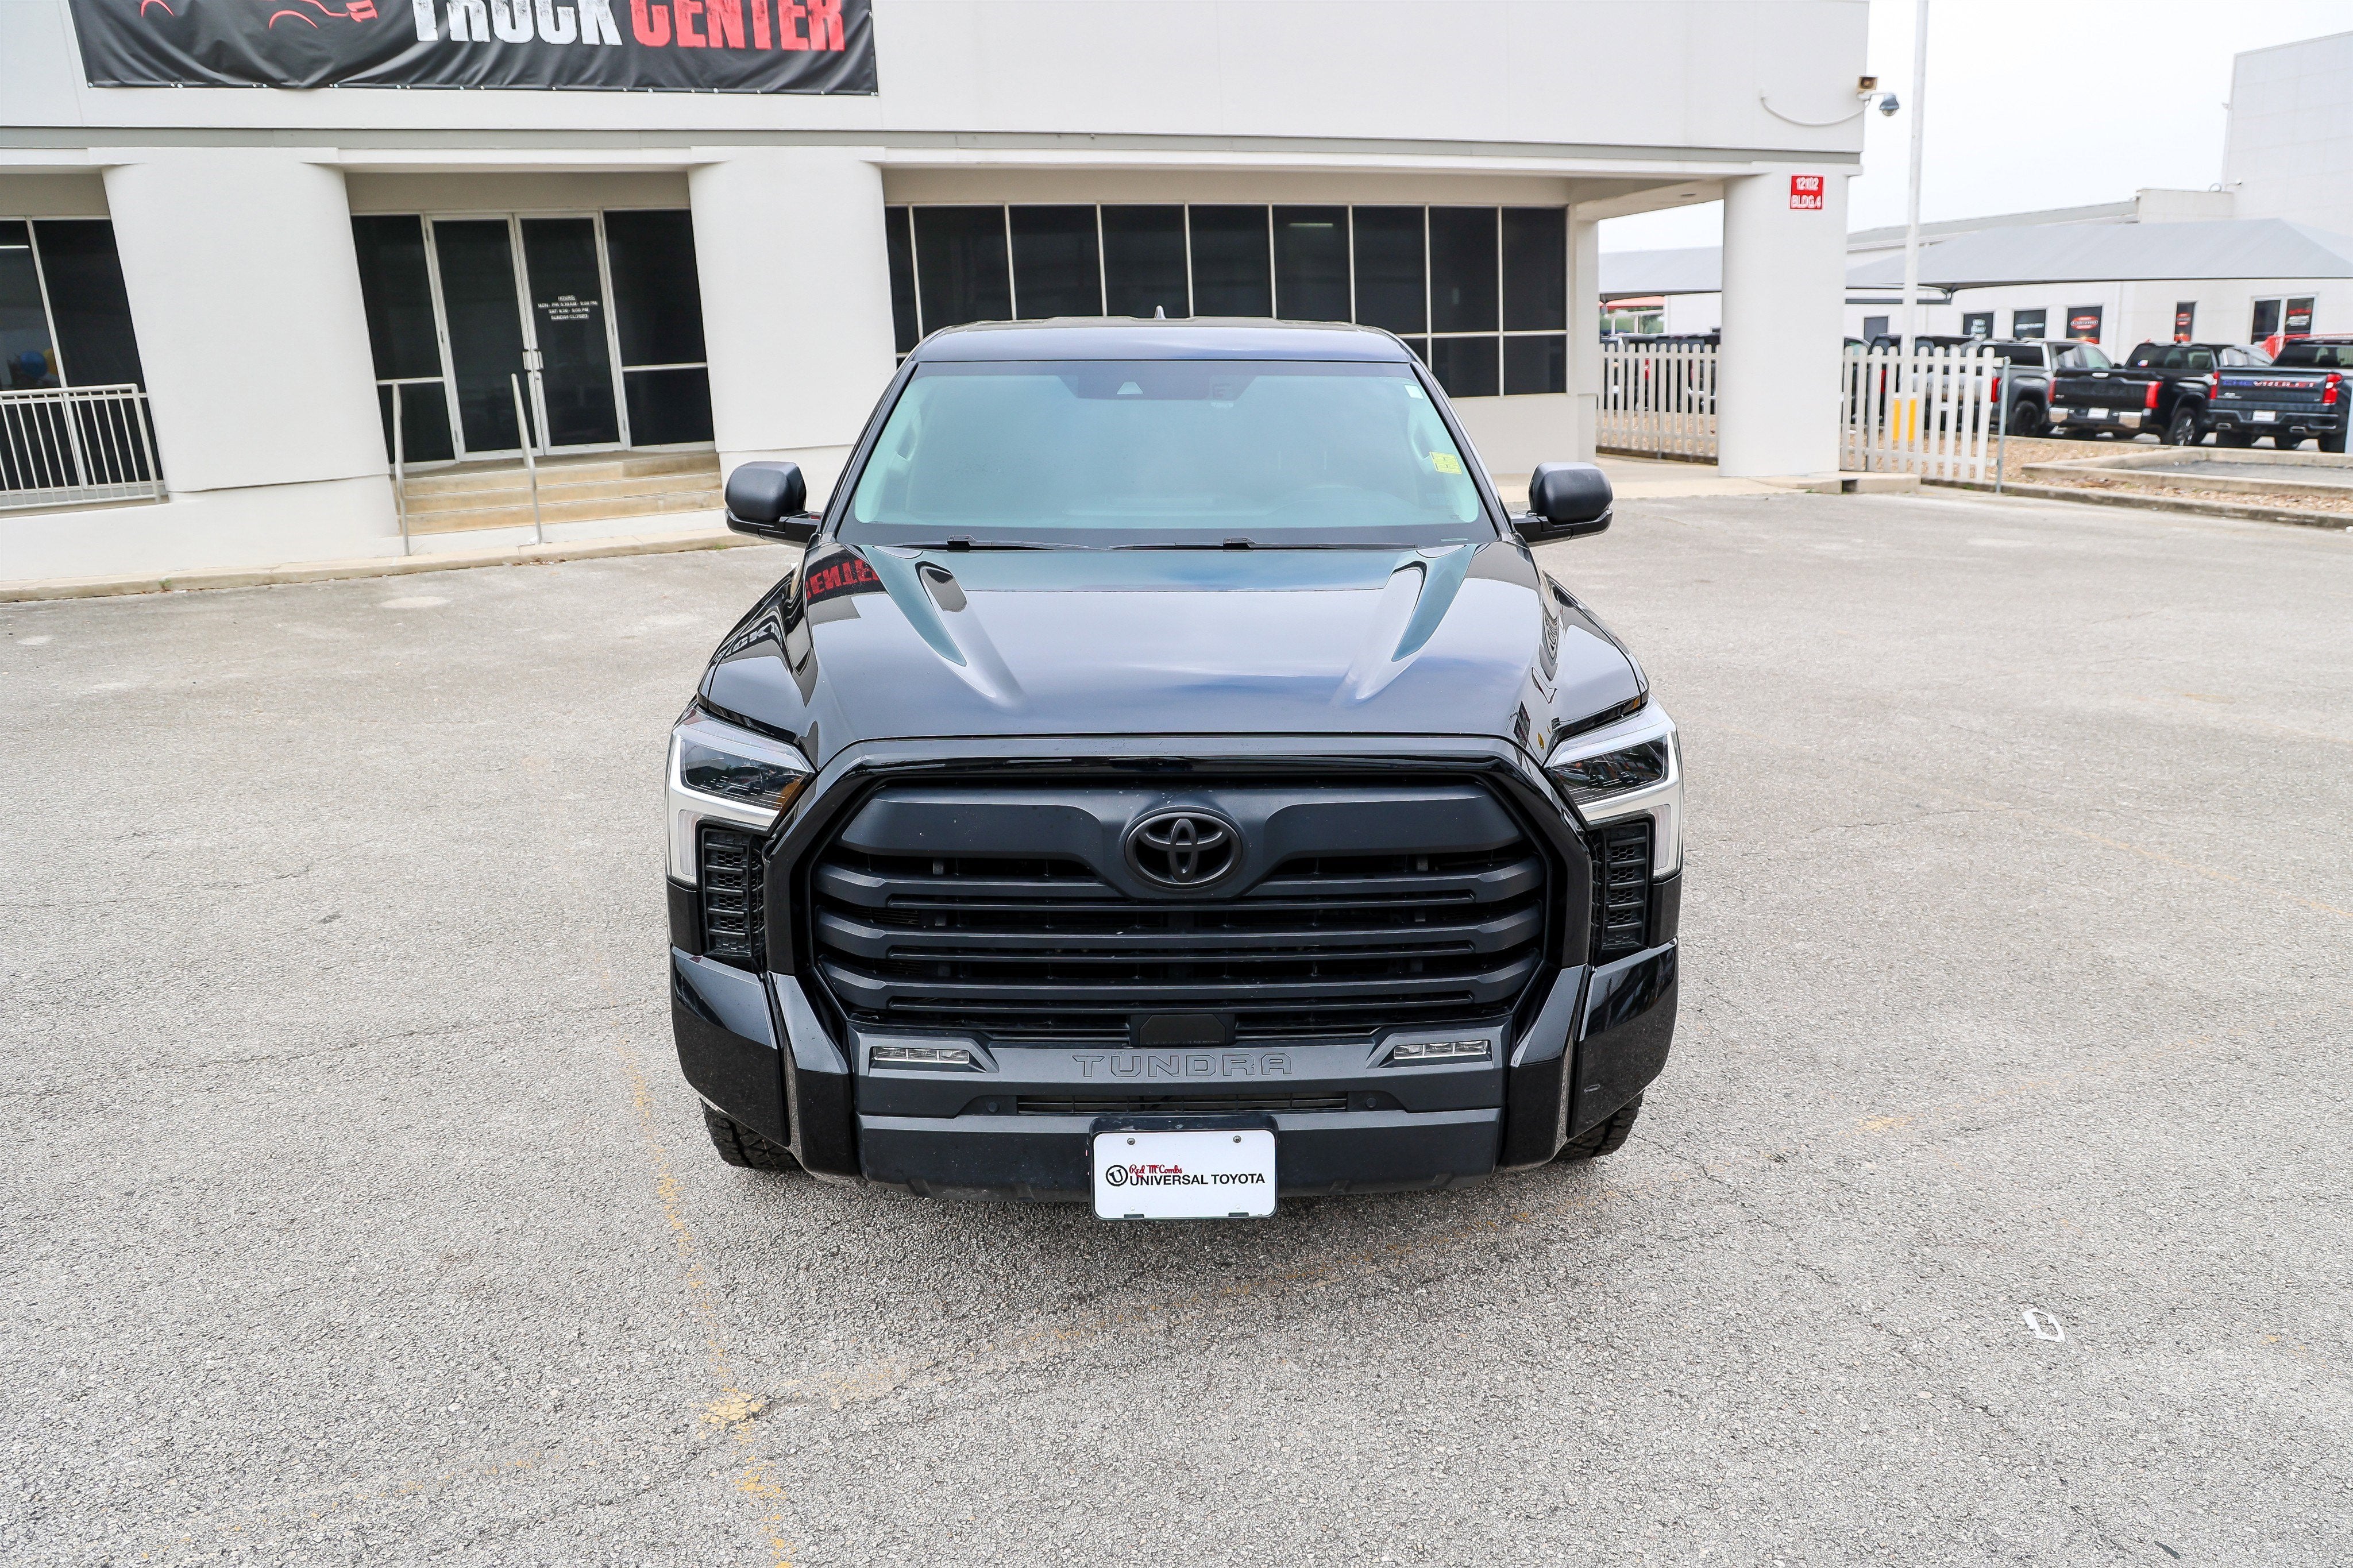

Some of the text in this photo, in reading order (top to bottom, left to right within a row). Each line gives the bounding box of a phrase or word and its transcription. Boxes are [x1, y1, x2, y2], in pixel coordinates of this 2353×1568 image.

[630, 0, 845, 51] CENTER
[1796, 177, 1819, 191] 12102
[1071, 1053, 1293, 1077] TUNDRA
[1129, 1164, 1182, 1178] Red McCombs
[1129, 1173, 1209, 1186] UNIVERSAL
[1211, 1172, 1266, 1185] TOYOTA
